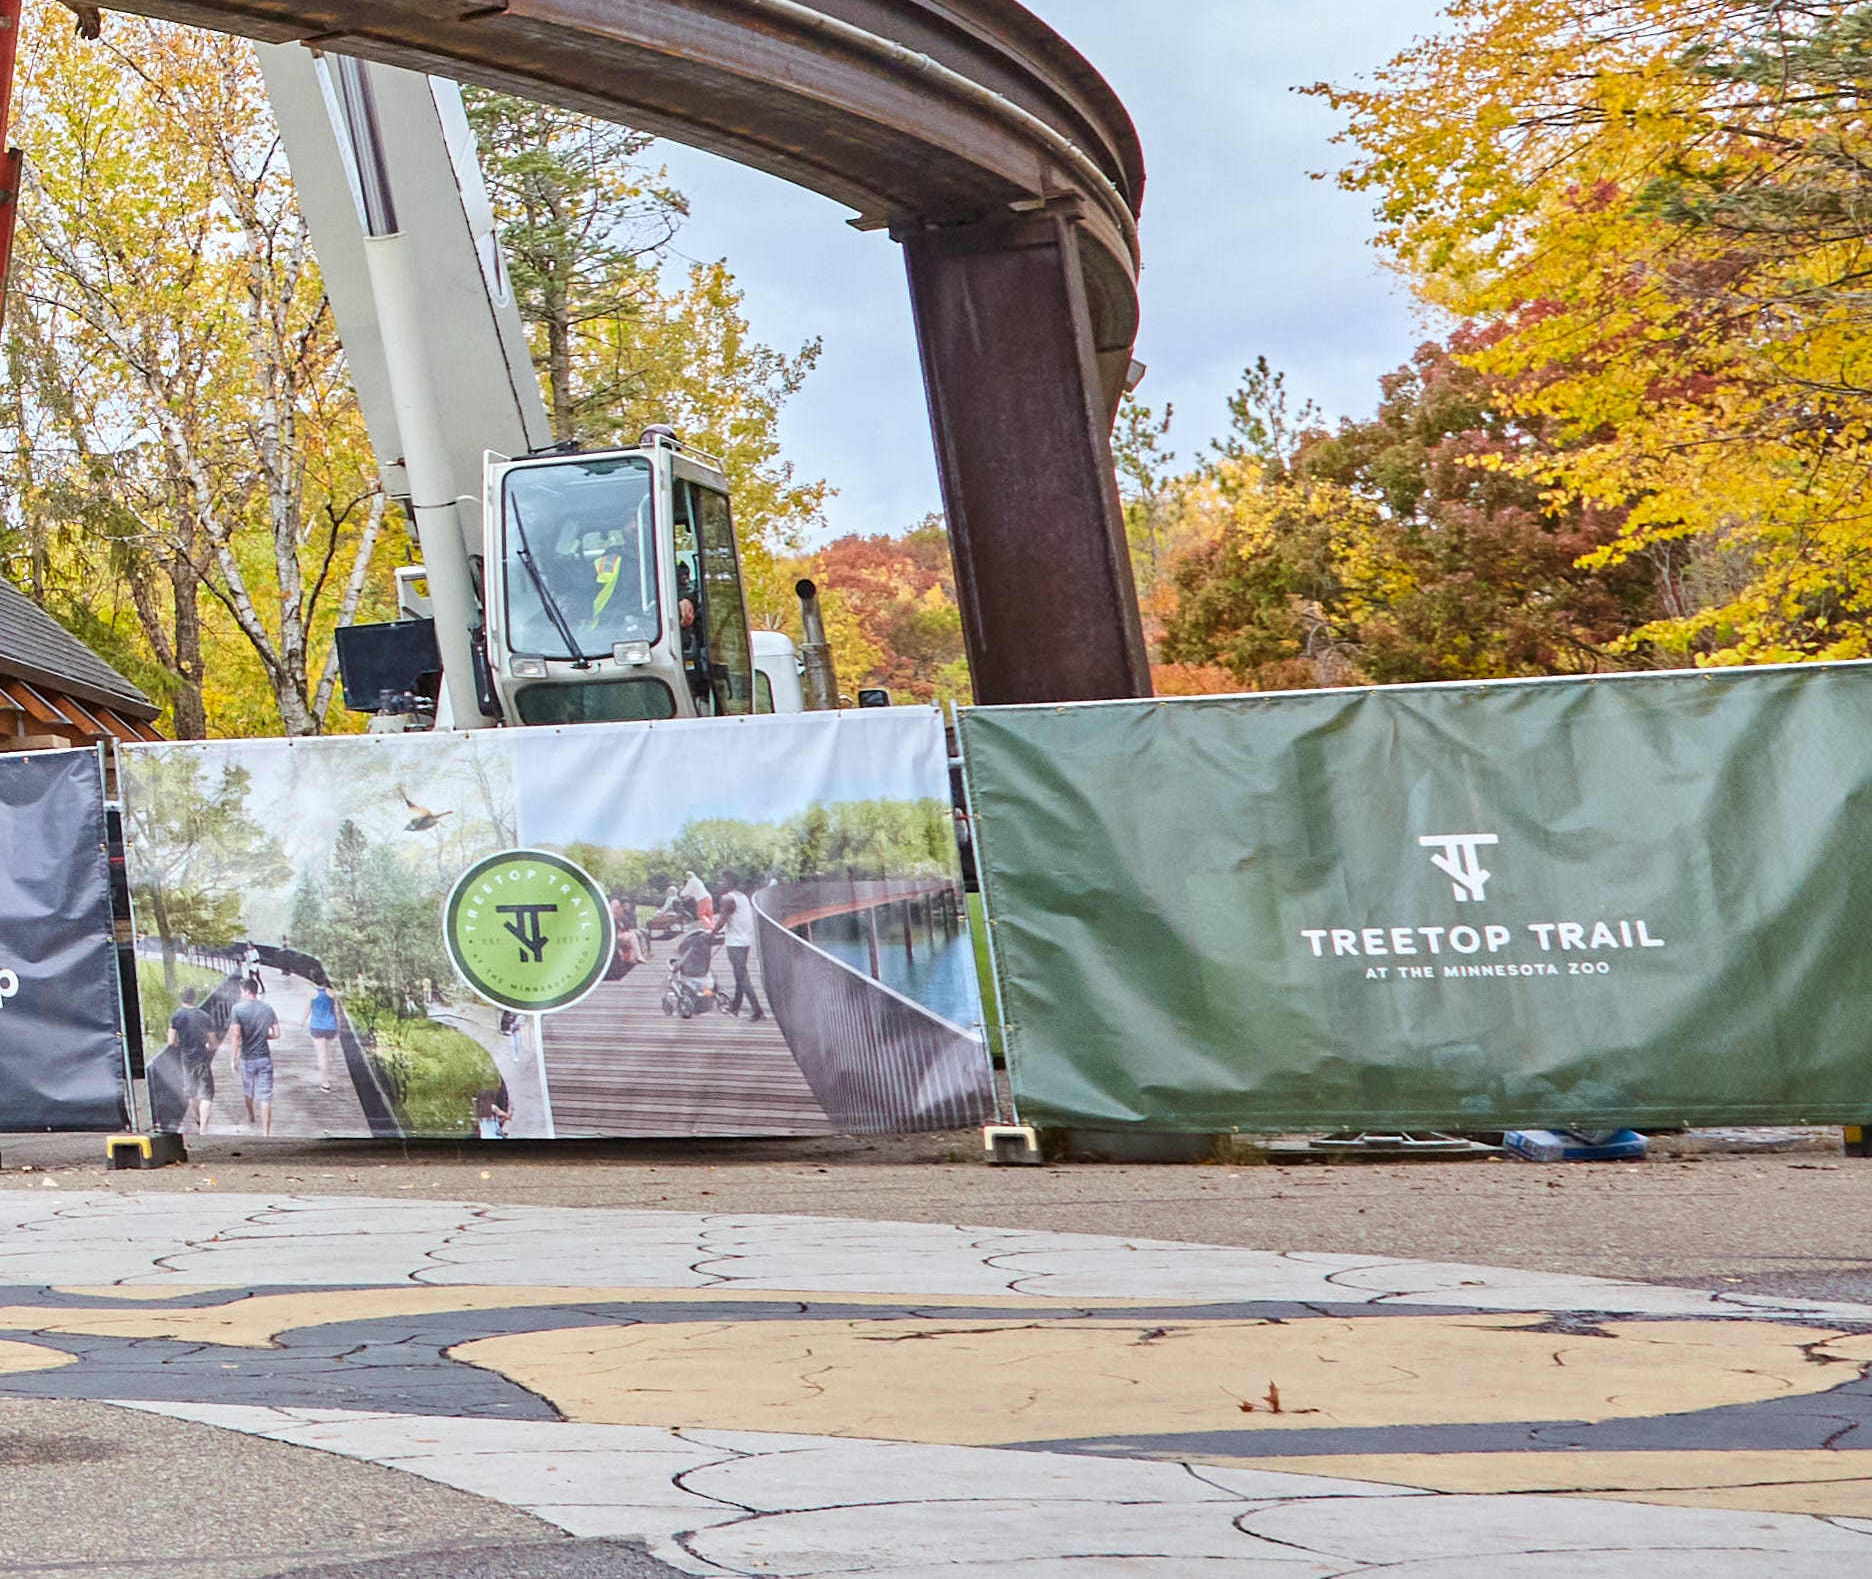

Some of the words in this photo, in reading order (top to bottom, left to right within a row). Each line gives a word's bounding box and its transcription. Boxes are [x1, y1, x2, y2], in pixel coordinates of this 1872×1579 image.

[465, 869, 537, 933] TREETOP
[548, 874, 592, 930] TRAIL
[1300, 924, 1512, 957] TREETOP
[1527, 920, 1666, 951] TRAIL
[1365, 966, 1388, 979] AT
[1397, 965, 1434, 979] THE
[1443, 963, 1559, 978] MINNESOTA
[1567, 961, 1611, 975] ZOO
